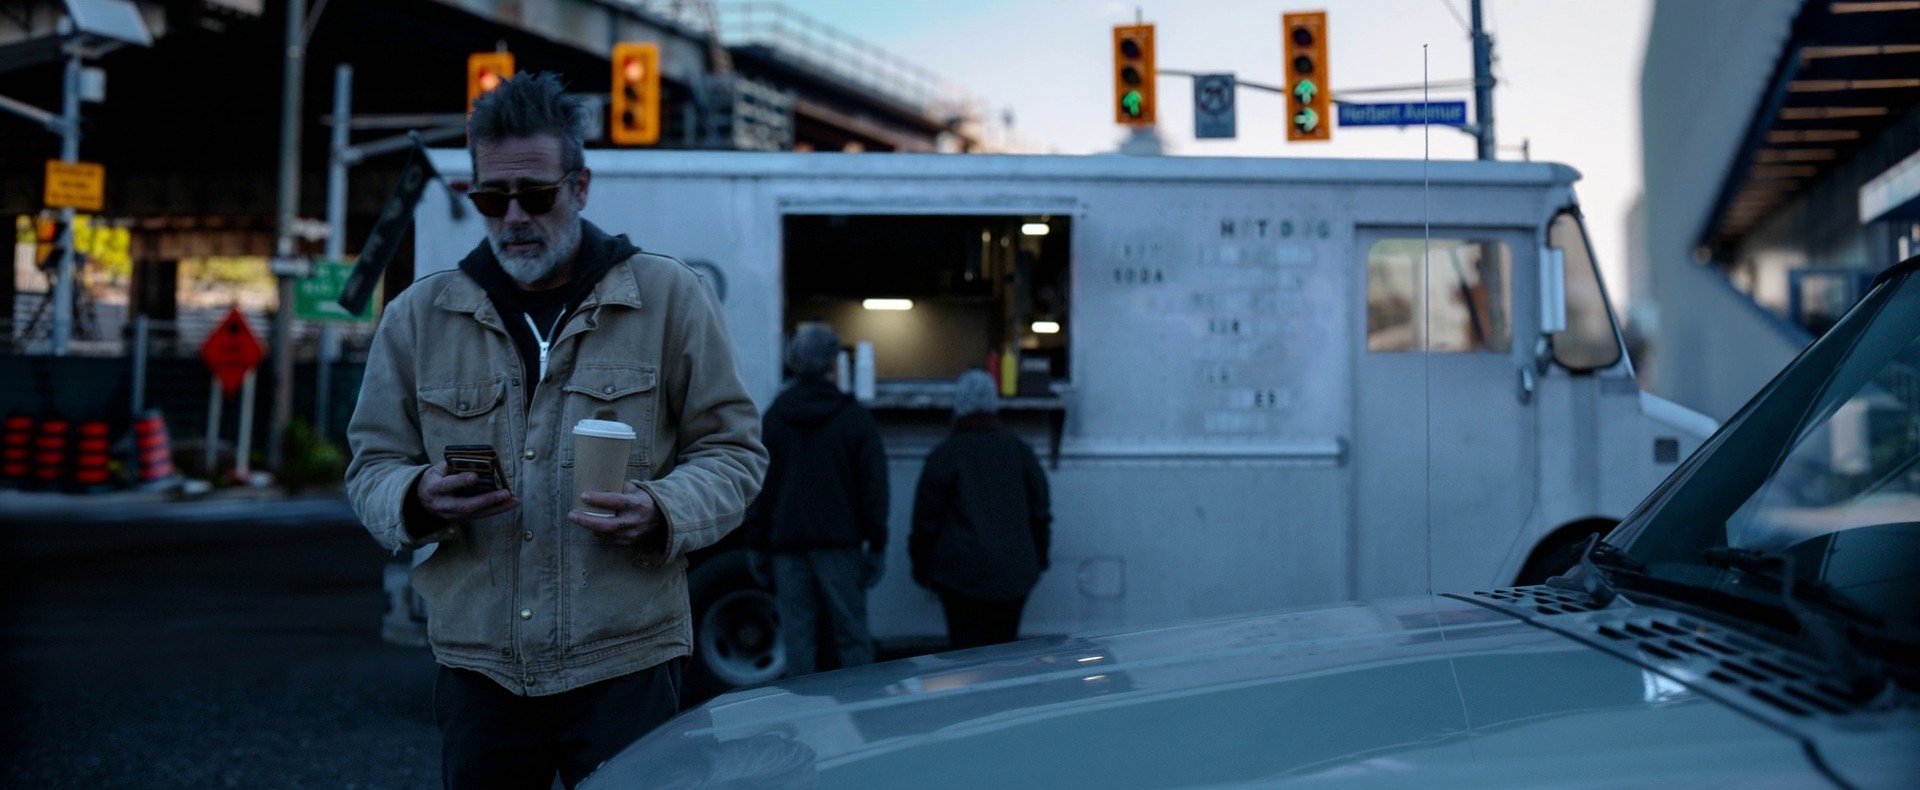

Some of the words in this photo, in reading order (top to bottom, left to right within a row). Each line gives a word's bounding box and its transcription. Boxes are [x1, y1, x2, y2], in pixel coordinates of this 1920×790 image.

[1404, 103, 1461, 120] Avenue
[1220, 219, 1268, 239] HT
[1280, 219, 1331, 239] DG
[1112, 267, 1164, 284] SODA
